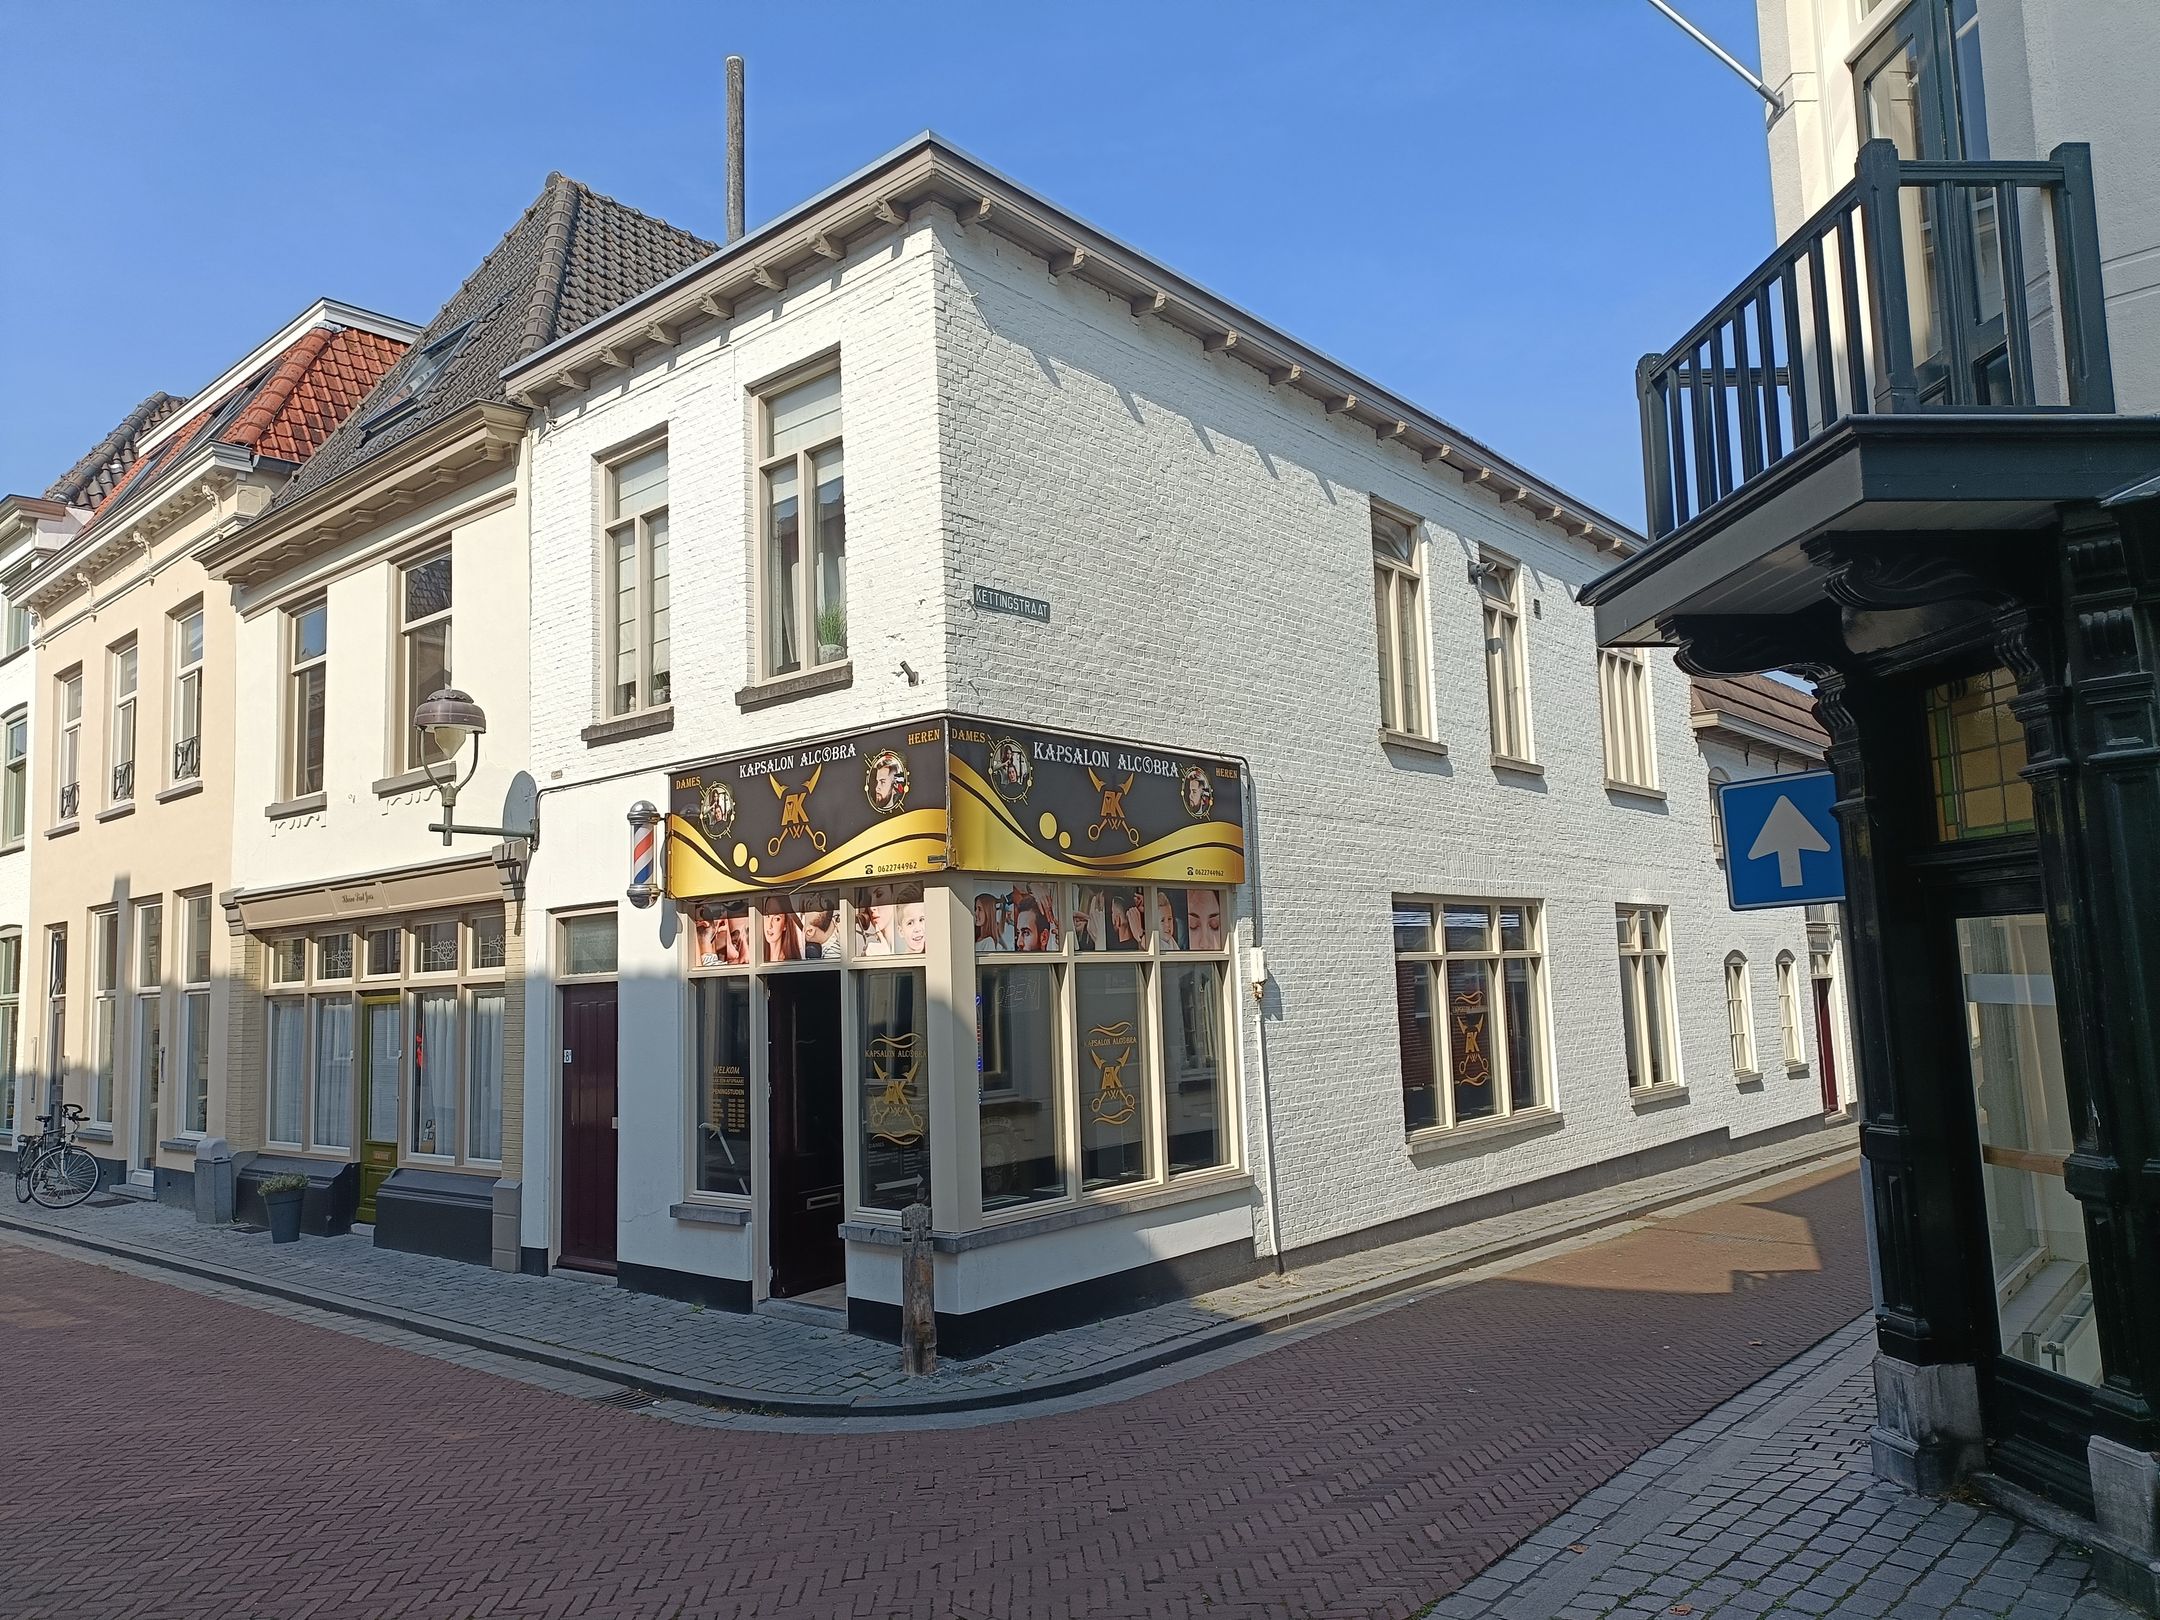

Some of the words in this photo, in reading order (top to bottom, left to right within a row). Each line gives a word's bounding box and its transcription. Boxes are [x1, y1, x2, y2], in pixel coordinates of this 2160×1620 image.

[976, 588, 1048, 618] KETTINGSTRAAT
[907, 729, 940, 746] HEREN
[951, 728, 986, 743] DAMES
[739, 755, 794, 779] KAPSALON
[799, 743, 856, 767] ALCOBRA
[1032, 742, 1110, 769] KAPSALON
[1117, 756, 1180, 778] ALCOBRA
[1215, 767, 1238, 779] HEREN
[675, 776, 701, 789] DAMES
[877, 862, 918, 873] 0622744962
[713, 1065, 740, 1075] WELKOM
